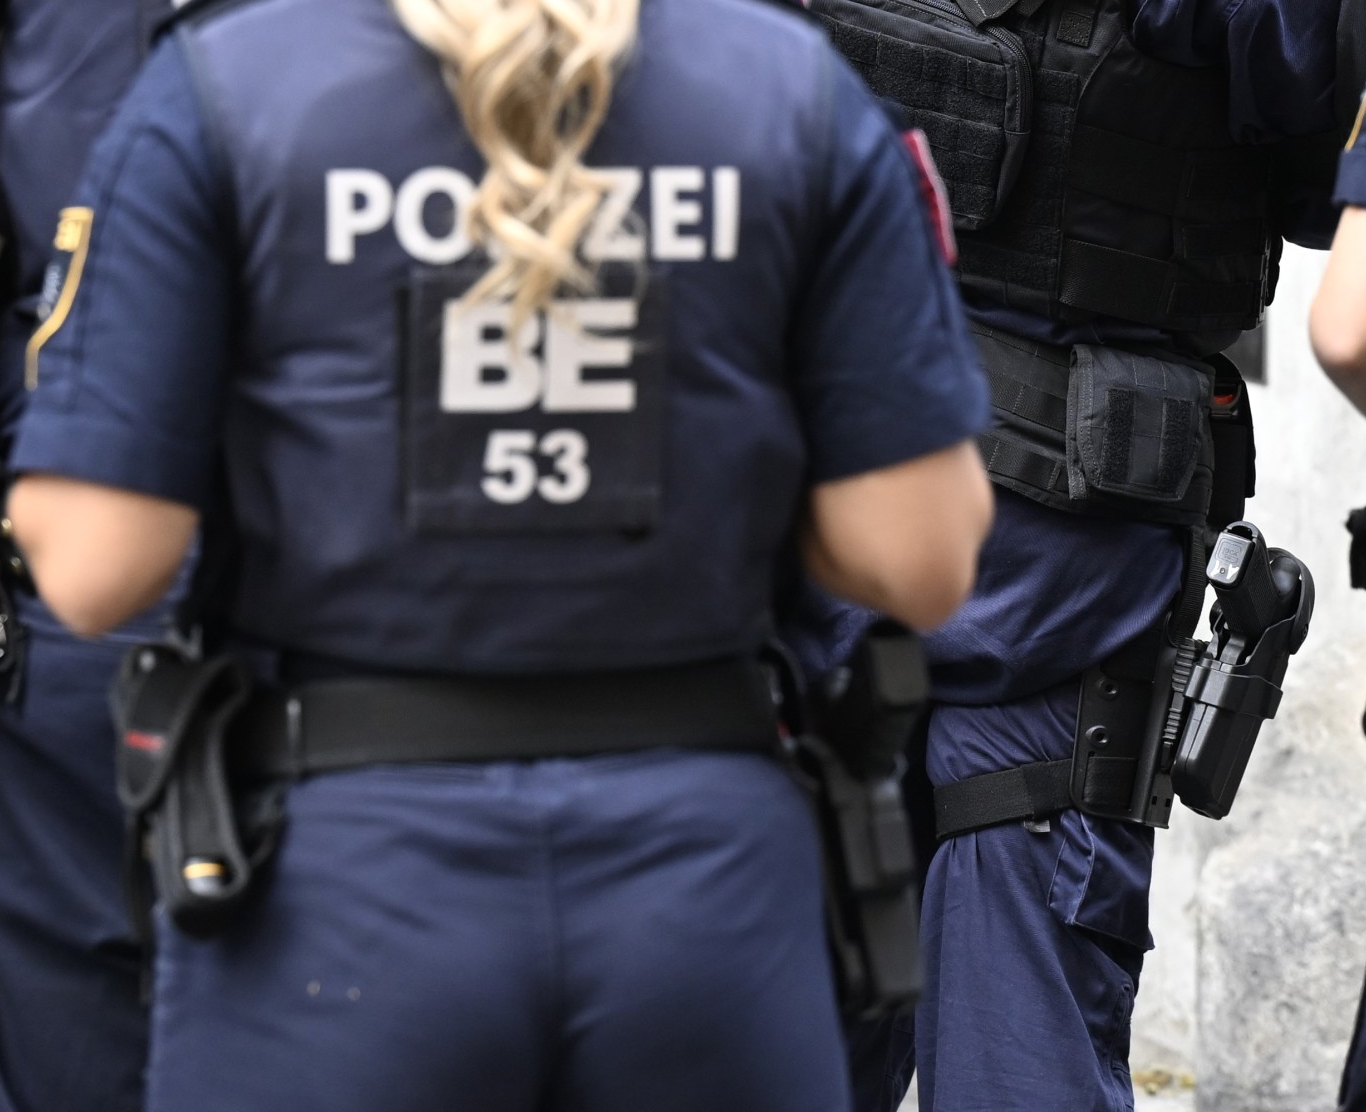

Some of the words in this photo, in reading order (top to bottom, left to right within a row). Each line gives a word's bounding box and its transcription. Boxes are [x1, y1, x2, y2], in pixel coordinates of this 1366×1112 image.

[325, 165, 741, 264] POZEI
[439, 295, 637, 413] BE
[481, 430, 590, 504] 53
